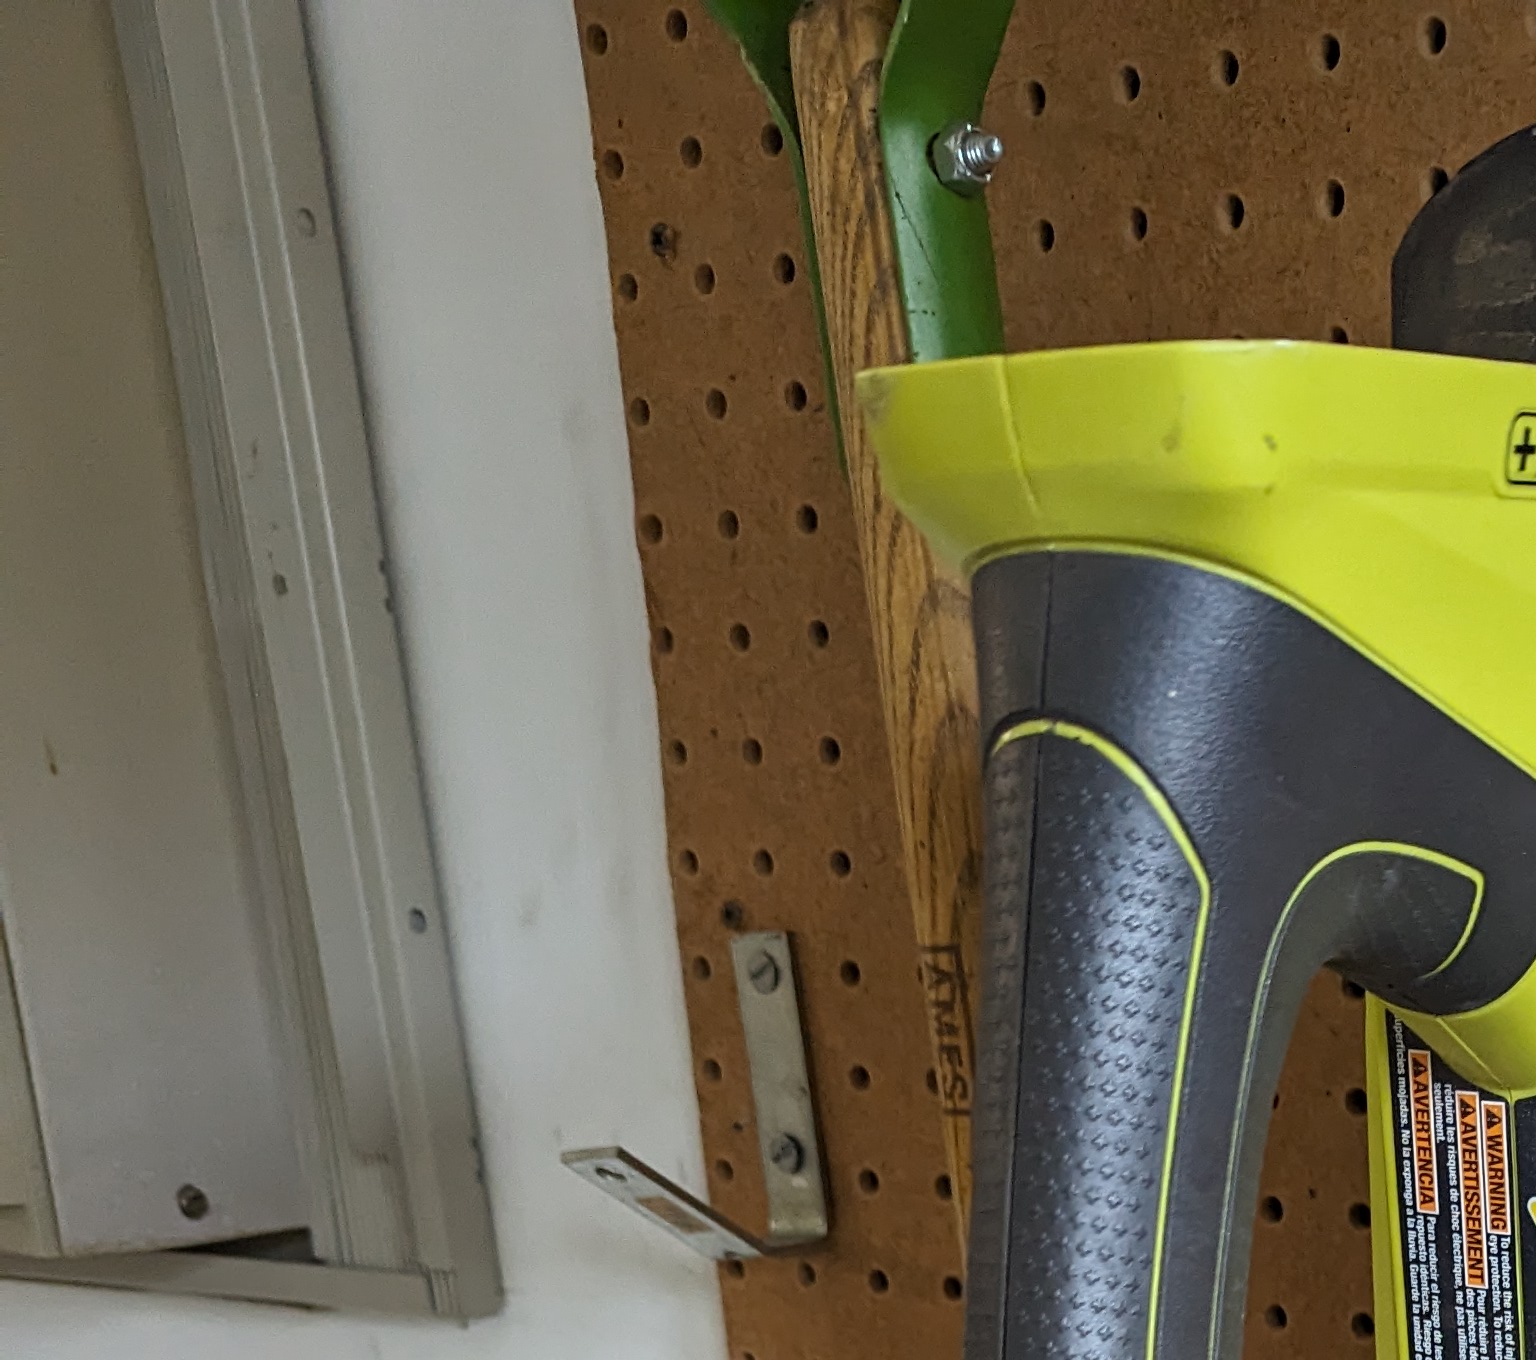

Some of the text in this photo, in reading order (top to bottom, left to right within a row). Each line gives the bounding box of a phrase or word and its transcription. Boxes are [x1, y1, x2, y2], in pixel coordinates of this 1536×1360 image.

[1401, 1129, 1410, 1145] No
[1413, 1080, 1435, 1206] AVERTENCIA
[1446, 1126, 1456, 1143] les
[1402, 1146, 1411, 1158] la
[1445, 1145, 1458, 1186] risques
[1400, 1159, 1412, 1206] exponga
[1487, 1134, 1507, 1230] WARNING
[1450, 1188, 1459, 1202] de
[1461, 1120, 1484, 1282] AVERTISSEMENT
[1406, 1217, 1415, 1228] la
[1451, 1204, 1461, 1231] choc
[1501, 1235, 1510, 1249] To
[1487, 1233, 1497, 1254] eye
[1493, 1315, 1502, 1328] To
[1502, 1251, 1512, 1289] reduce
[1409, 1263, 1420, 1301] Guarde
[1455, 1290, 1463, 1304] ne
[1466, 1287, 1475, 1308] des
[1477, 1289, 1487, 1314] Pour
[1503, 1290, 1513, 1308] the
[1411, 1303, 1421, 1314] la
[1454, 1306, 1464, 1326] pas
[1504, 1310, 1514, 1332] risk
[1412, 1315, 1423, 1352] unidad
[1505, 1333, 1514, 1345] of
